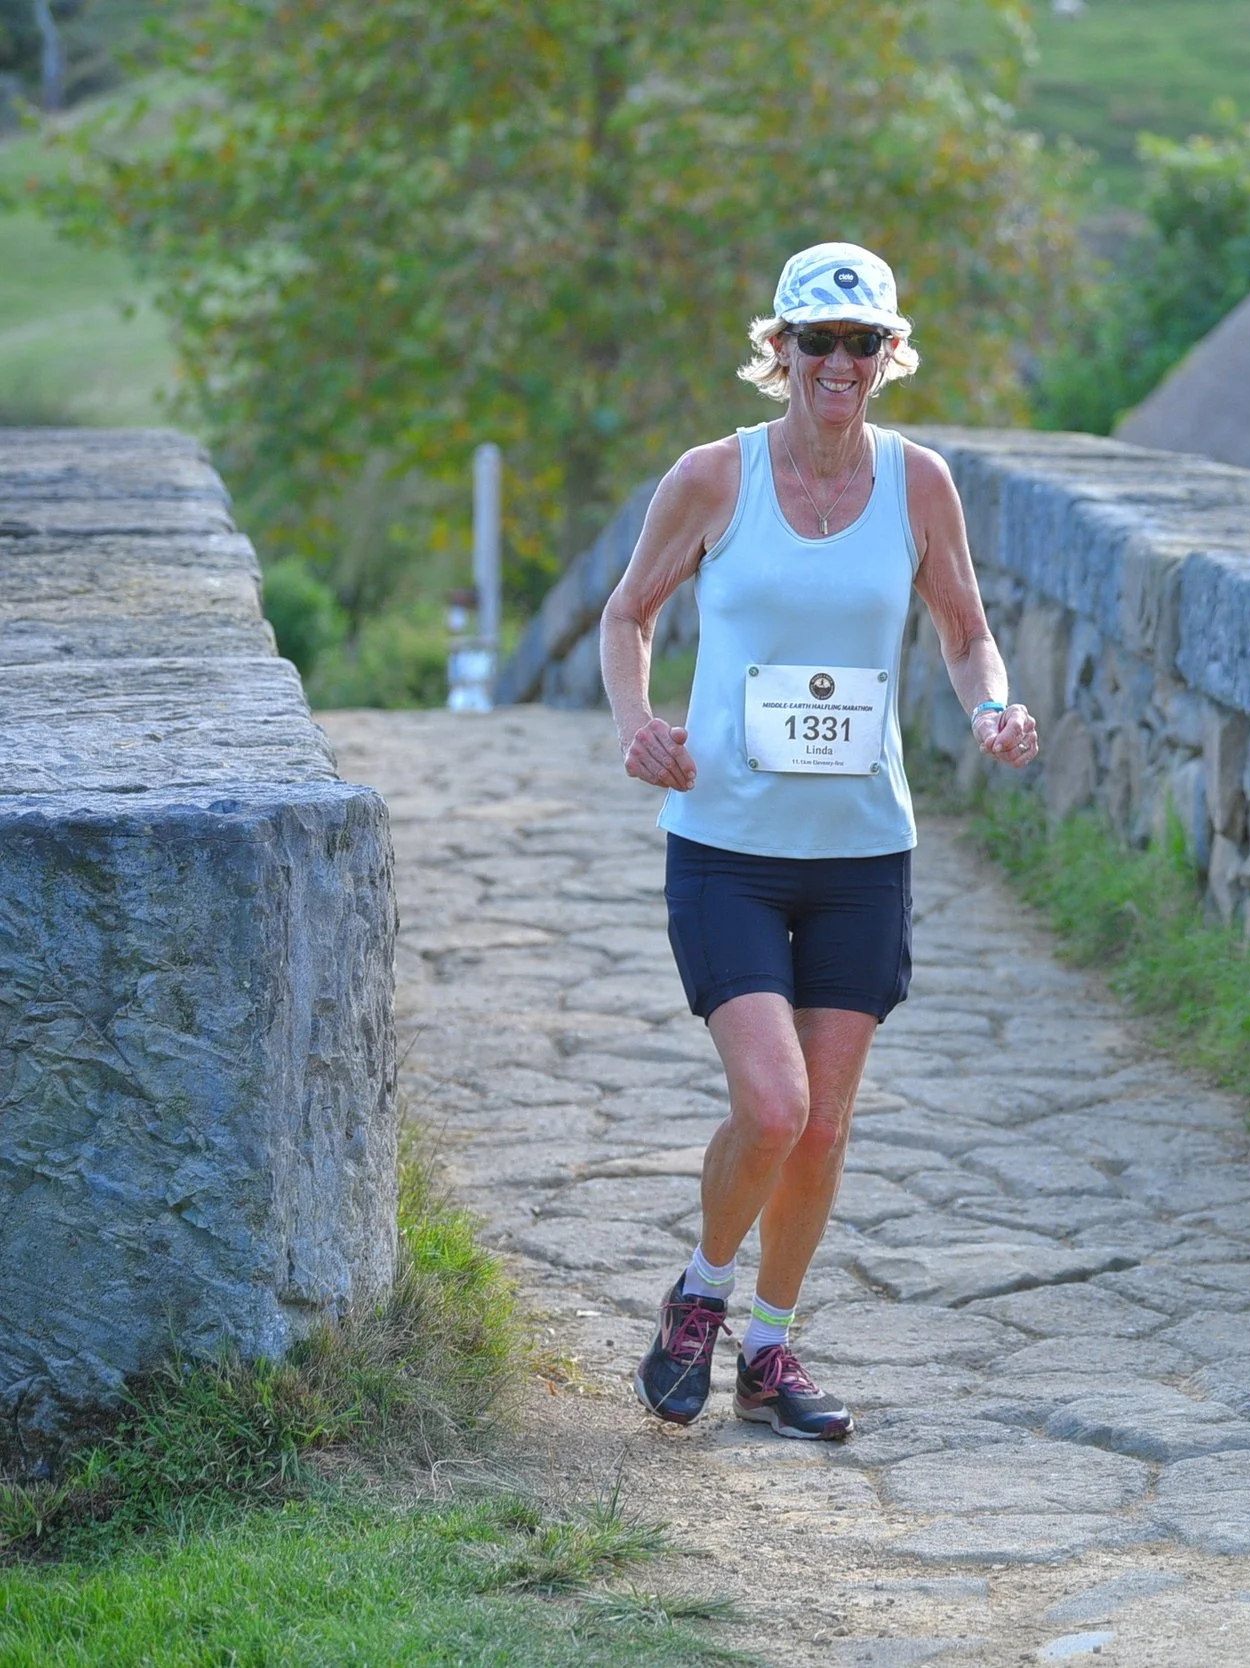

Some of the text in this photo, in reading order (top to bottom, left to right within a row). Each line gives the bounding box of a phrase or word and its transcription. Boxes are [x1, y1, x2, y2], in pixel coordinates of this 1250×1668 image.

[811, 703, 841, 711] HALFLING
[785, 715, 850, 742] 1331
[806, 745, 833, 755] Linda
